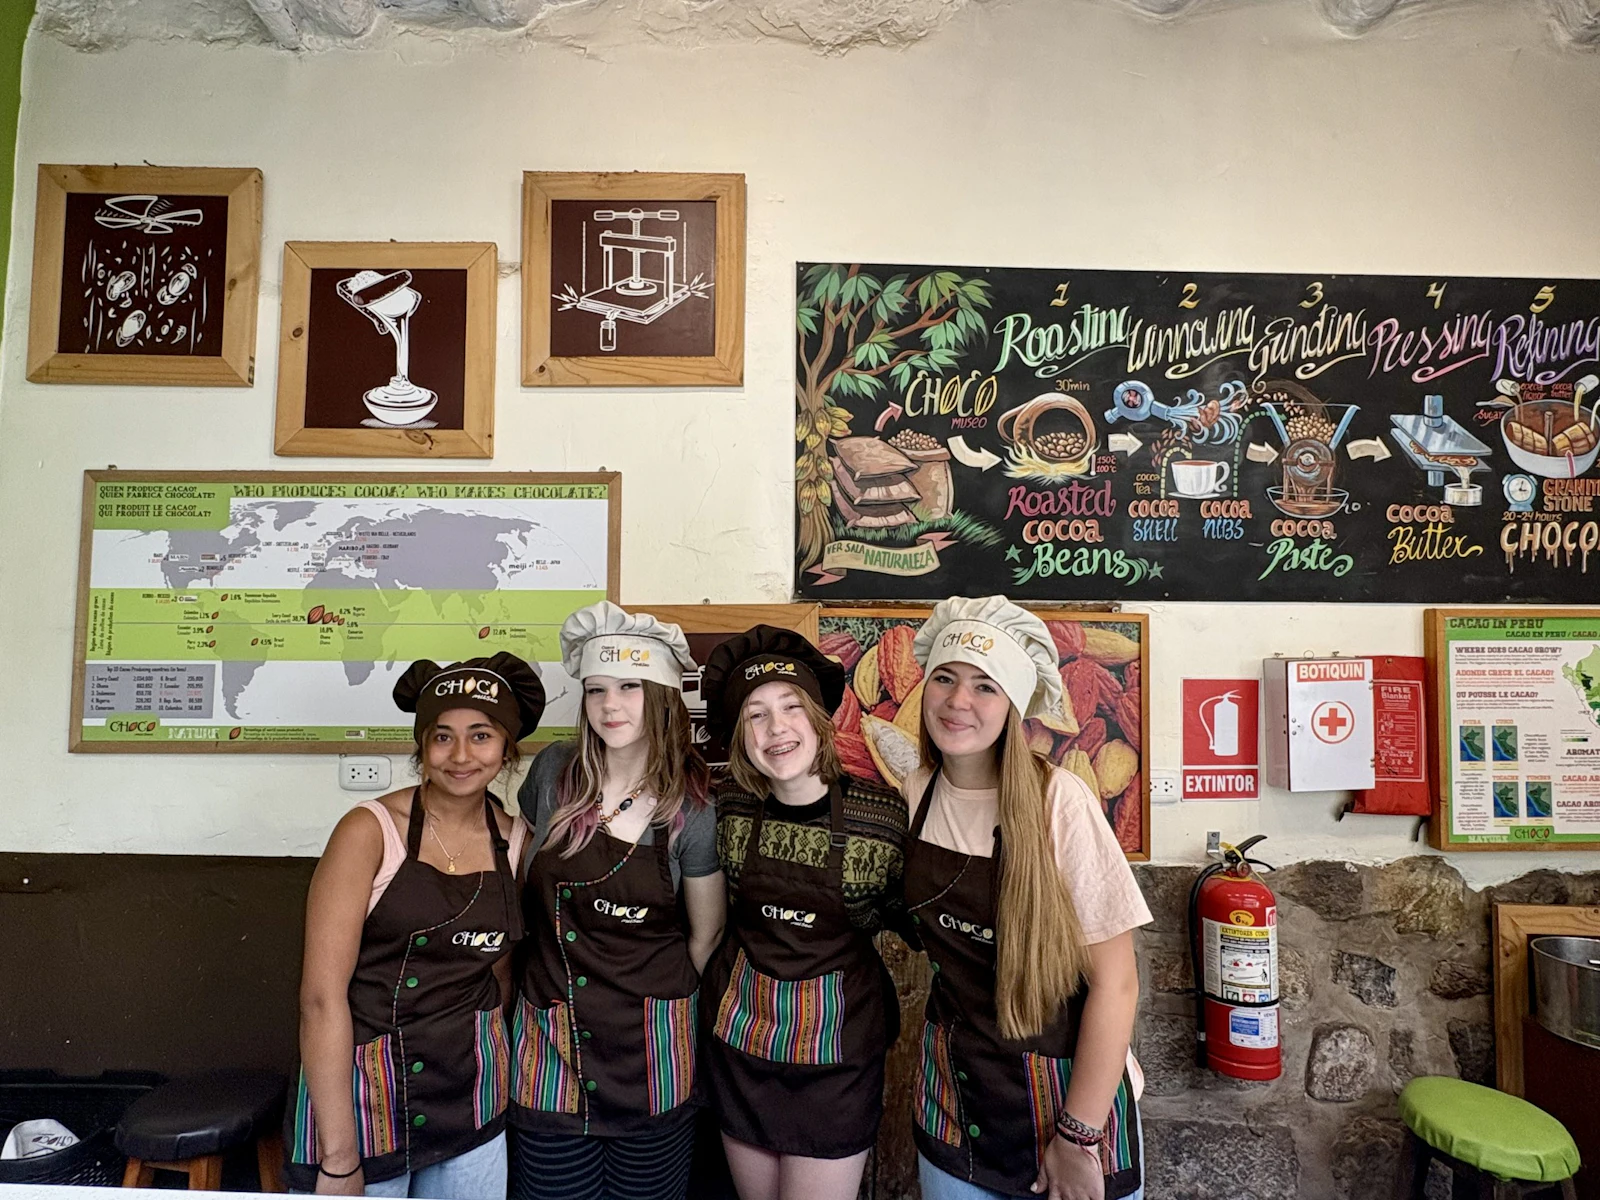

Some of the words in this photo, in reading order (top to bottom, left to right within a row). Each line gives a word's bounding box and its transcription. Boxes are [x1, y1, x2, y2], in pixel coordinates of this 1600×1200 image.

[1178, 283, 1201, 308] 2
[1298, 281, 1323, 308] 3
[1426, 282, 1447, 309] 4
[1529, 285, 1557, 313] 5
[992, 304, 1131, 378] Roasting
[905, 370, 998, 418] CHOCO
[233, 485, 264, 497] WHO
[272, 485, 346, 497] PRODUCES
[354, 485, 409, 498] COCOA?
[416, 486, 448, 498] WHO
[455, 486, 506, 498] MAKES
[513, 486, 607, 498] CHOCOLATE?
[1133, 482, 1151, 495] Tea
[1003, 480, 1117, 520] Roasted
[1543, 496, 1593, 512] STONE
[1534, 511, 1562, 522] hours
[1387, 521, 1483, 565] Butter
[1500, 521, 1600, 562] CHOCO
[827, 542, 842, 554] VER
[845, 543, 864, 554] SALA
[864, 549, 935, 569] NATURALEZA
[1026, 542, 1134, 580] Beans
[1257, 537, 1354, 581] Paste
[1450, 619, 1490, 629] CACAO
[1492, 619, 1507, 628] IN
[1510, 619, 1544, 628] PERU
[942, 631, 995, 651] CHOCO
[599, 648, 649, 662] CHOCO
[745, 662, 794, 680] CHOCO
[1299, 662, 1363, 679] BOTIQUIN
[435, 677, 498, 698] CHOCO
[110, 721, 156, 732] CHOCO
[1185, 774, 1255, 793] EXTINTOR
[1514, 828, 1550, 839] CHOCO
[594, 898, 649, 919] CHOCO
[761, 904, 816, 924] CHOCO
[938, 913, 993, 940] CHOCO
[452, 930, 505, 946] CHOCO
